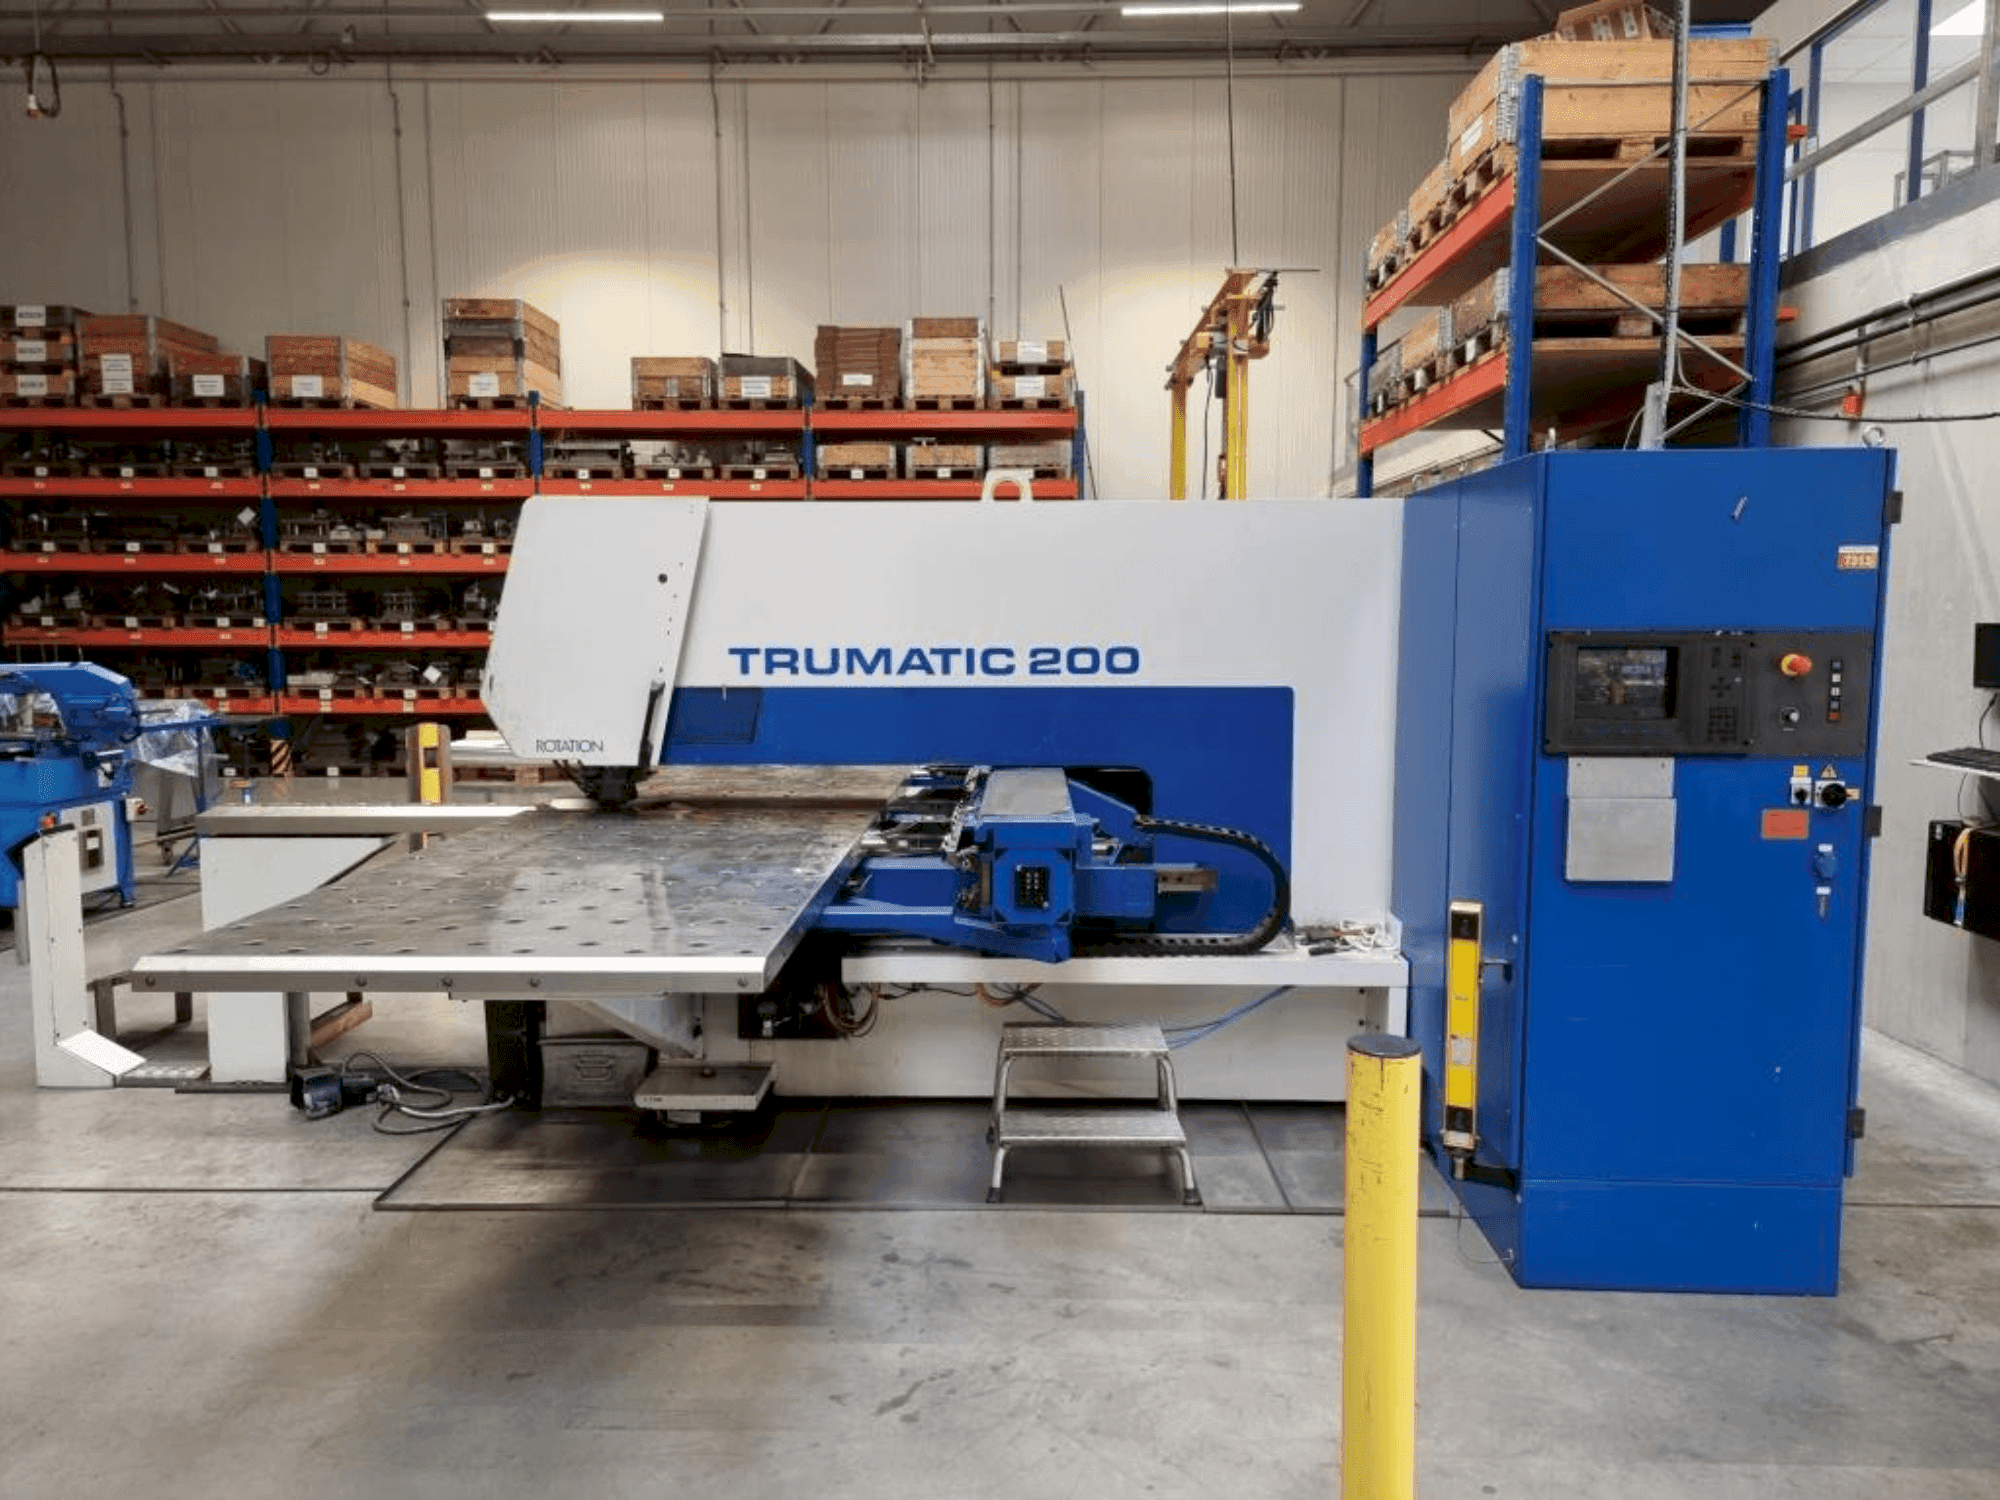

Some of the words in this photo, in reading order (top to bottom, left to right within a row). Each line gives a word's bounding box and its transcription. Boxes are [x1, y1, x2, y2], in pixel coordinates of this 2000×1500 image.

[728, 647, 1017, 676] TRUMATIC
[1028, 647, 1140, 676] 200
[535, 739, 604, 753] ROTATION
